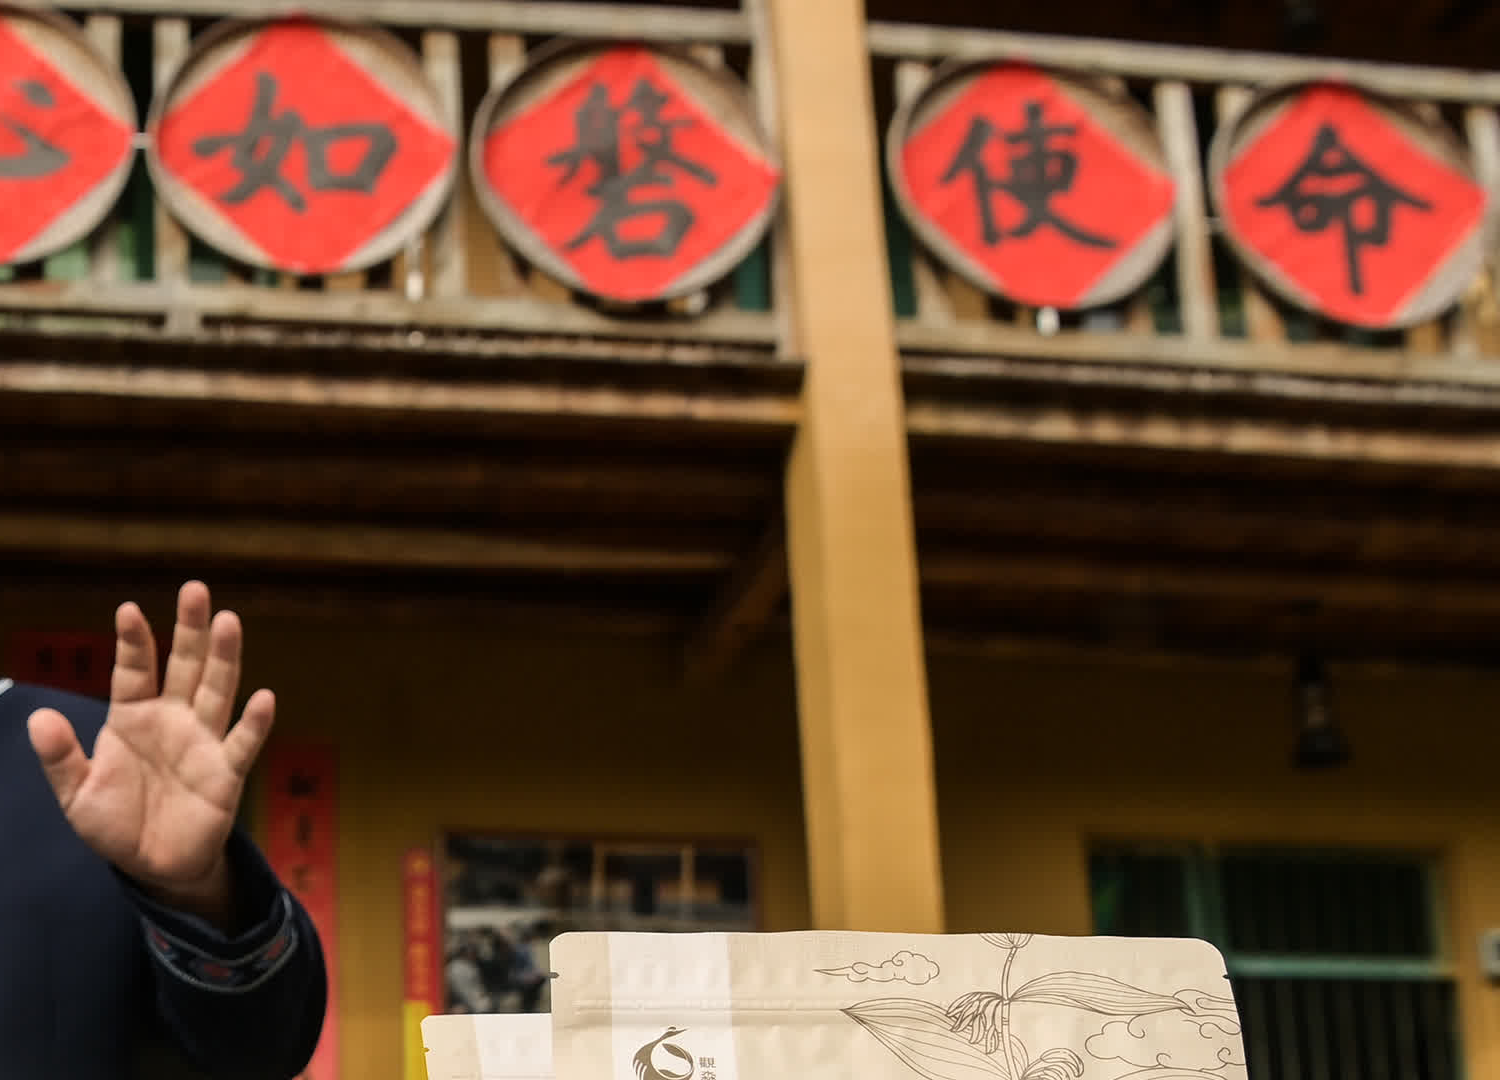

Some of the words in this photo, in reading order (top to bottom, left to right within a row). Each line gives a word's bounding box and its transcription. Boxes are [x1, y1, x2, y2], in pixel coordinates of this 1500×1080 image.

[192, 71, 398, 212] 如
[545, 77, 719, 260] 磐
[939, 102, 1118, 250] 使
[1256, 126, 1432, 295] 命
